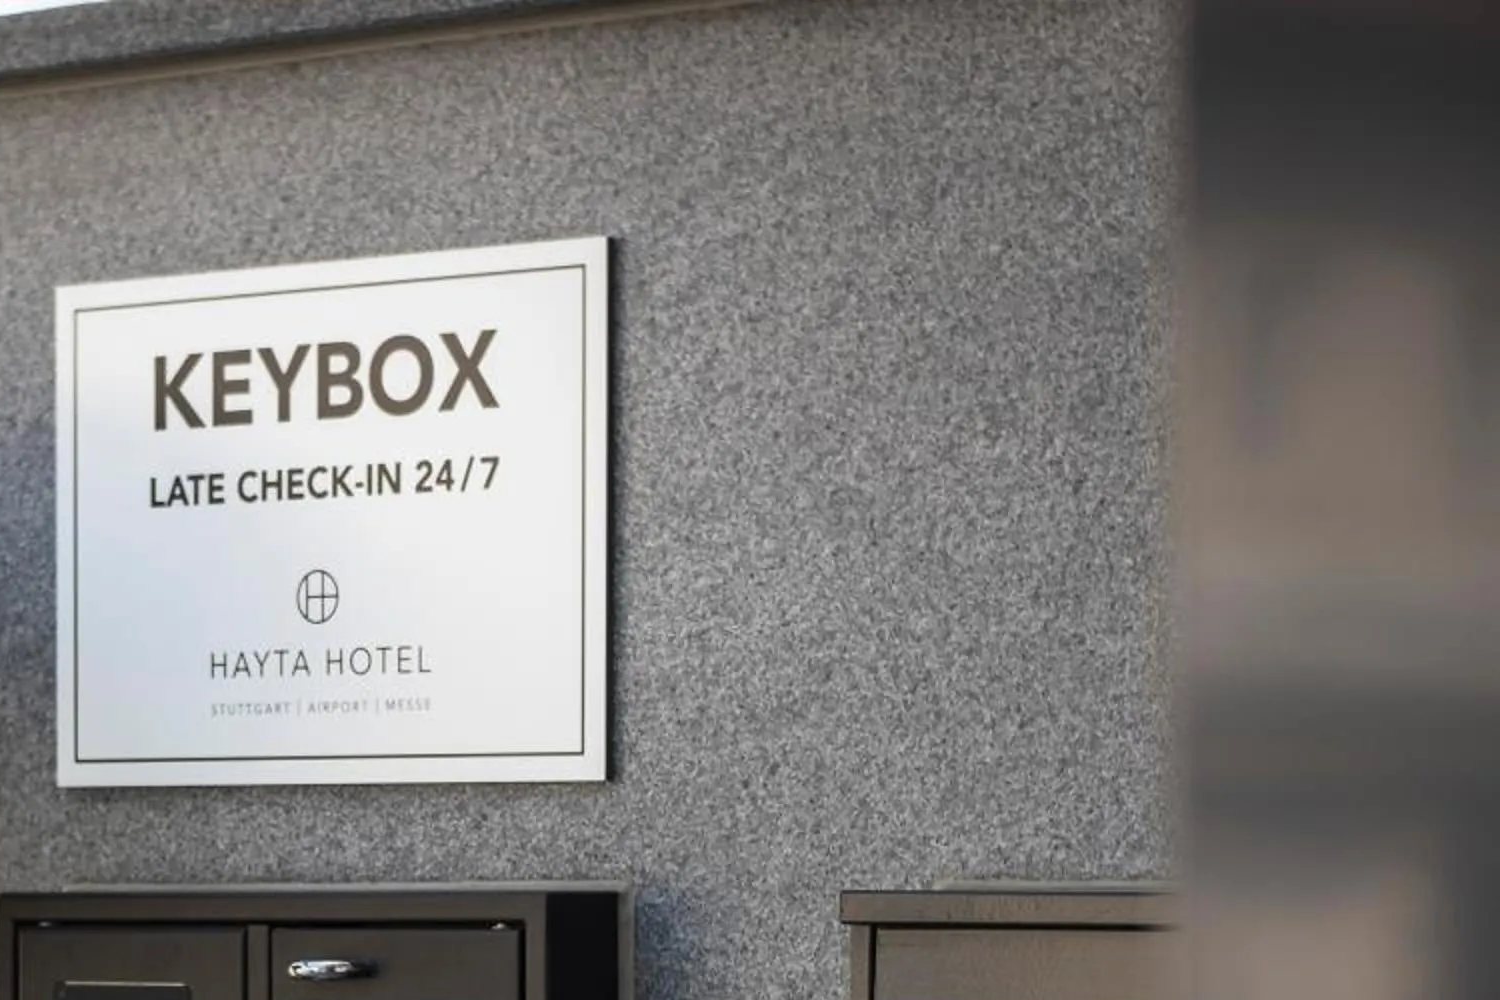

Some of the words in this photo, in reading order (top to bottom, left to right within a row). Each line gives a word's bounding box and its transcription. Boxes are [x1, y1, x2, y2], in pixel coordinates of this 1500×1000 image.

[154, 329, 500, 431] KEYBOX
[150, 473, 226, 508] LATE
[237, 462, 402, 503] CHECK-IN
[414, 456, 500, 493] 24/7
[210, 649, 311, 680] HAYTA
[326, 645, 432, 676] HOTEL
[211, 702, 291, 718] STUTTGART
[308, 699, 368, 714] AIRPORT
[385, 697, 431, 711] MESSE
